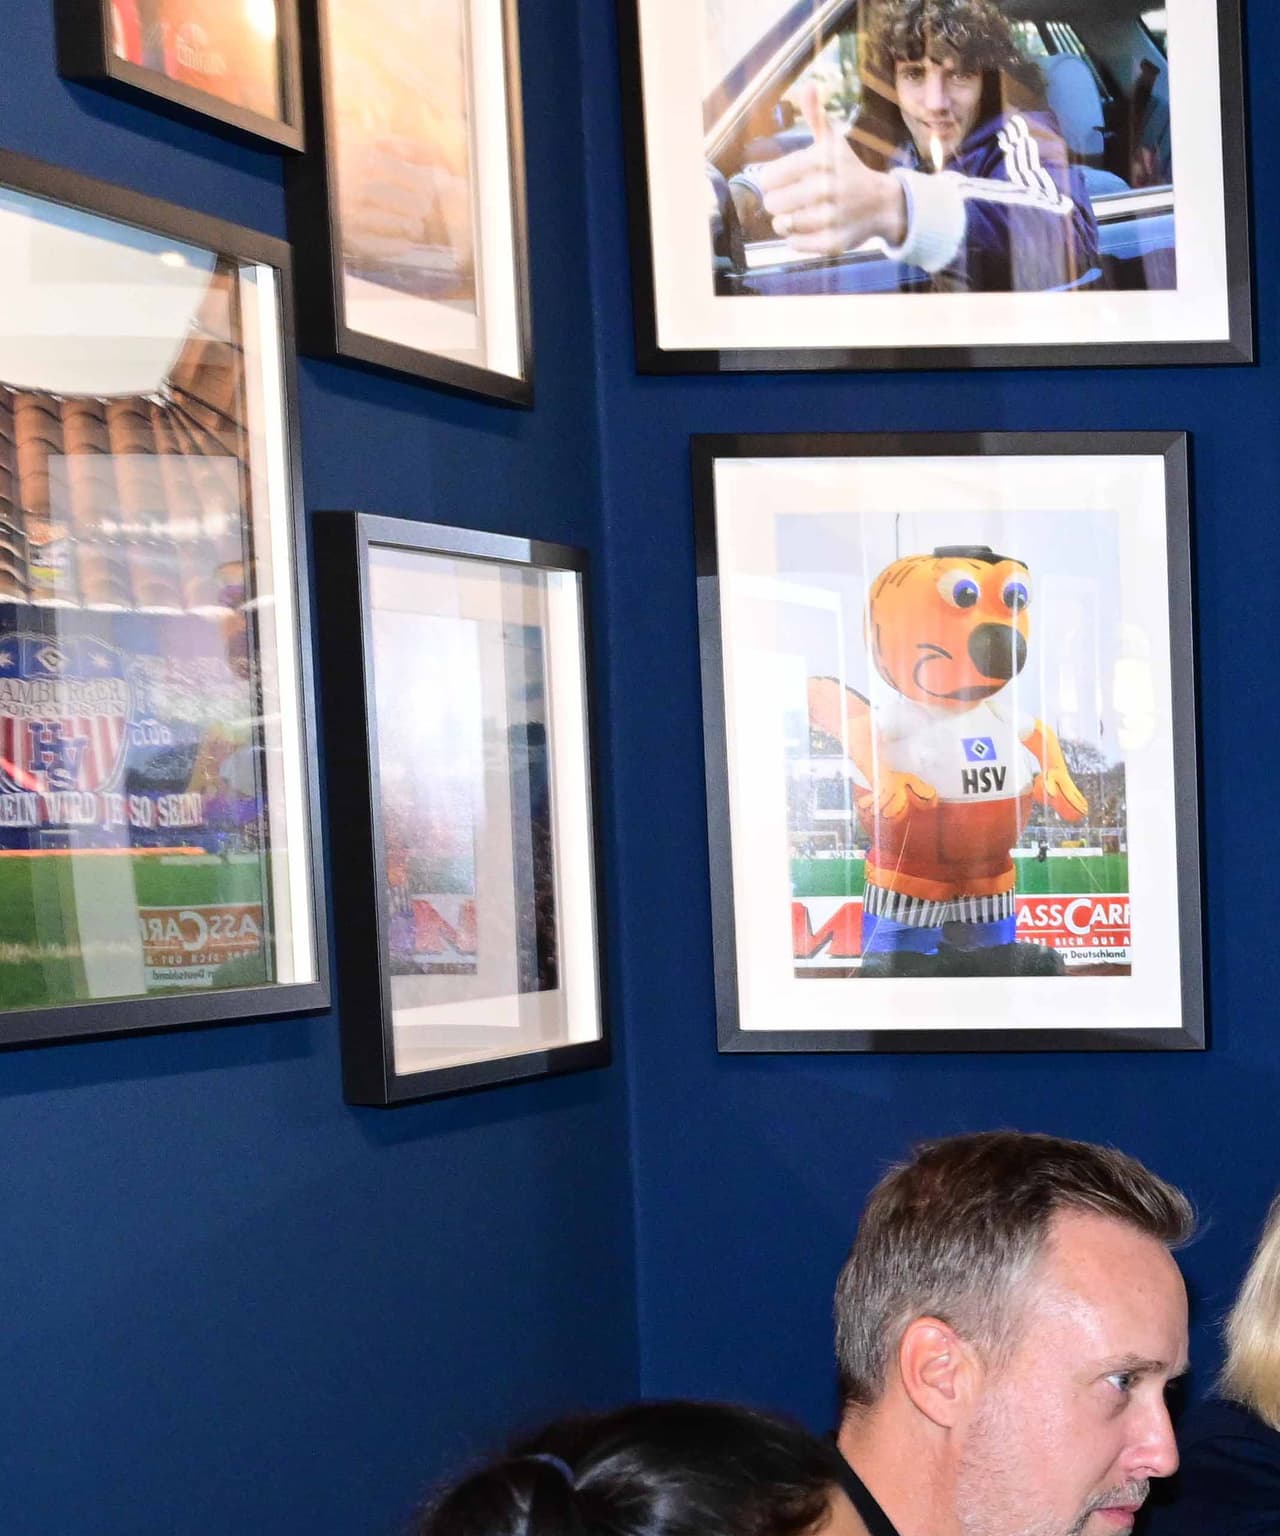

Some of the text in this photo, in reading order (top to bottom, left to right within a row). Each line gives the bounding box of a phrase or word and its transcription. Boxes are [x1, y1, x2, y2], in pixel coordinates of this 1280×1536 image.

[961, 766, 1007, 795] HSV
[0, 792, 37, 827] EIN
[45, 791, 97, 825] WIRD
[129, 793, 153, 829] SO
[1070, 949, 1126, 959] Deutschland
